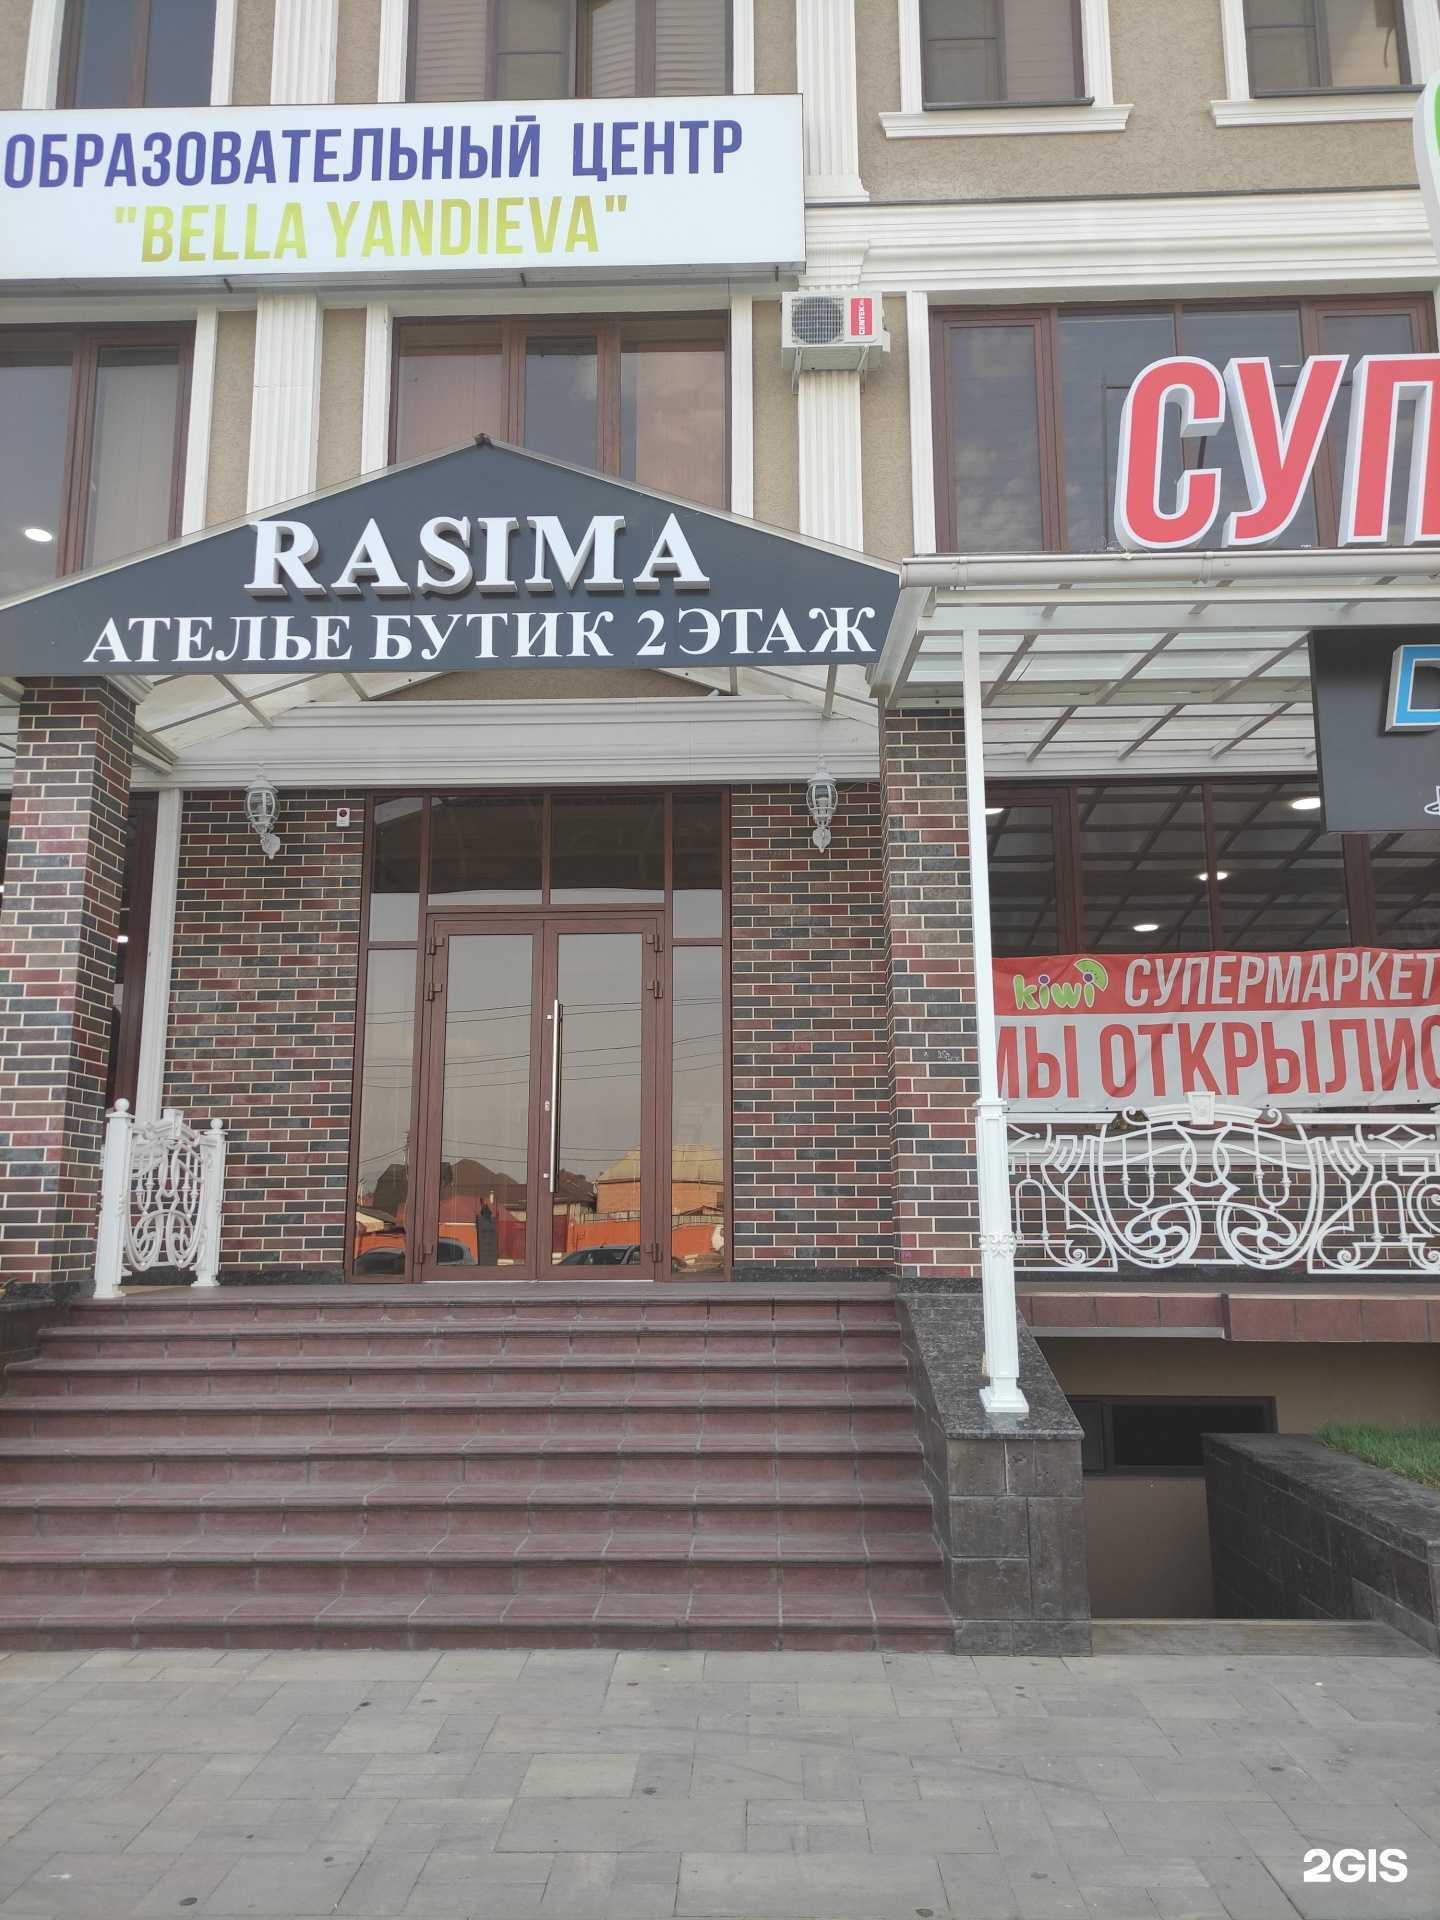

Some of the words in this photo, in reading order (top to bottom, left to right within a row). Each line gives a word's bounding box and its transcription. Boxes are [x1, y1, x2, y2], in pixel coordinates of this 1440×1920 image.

[4, 115, 541, 188] ОБРАЗОВАТЕЛЬНЫЙ
[572, 119, 743, 181] ЦЕНТР
[114, 202, 307, 262] "BELLA
[326, 194, 628, 258] YANDIEVA"
[243, 512, 711, 598] RASIMA
[83, 616, 353, 664] АТЕЛЬЕ
[371, 612, 615, 662] БУТИК
[637, 608, 667, 657] 2
[678, 606, 877, 656] ЭТАЖ
[1013, 973, 1098, 1010] kiwi
[1124, 951, 1440, 1008] СУПЕРМАРКЕТ
